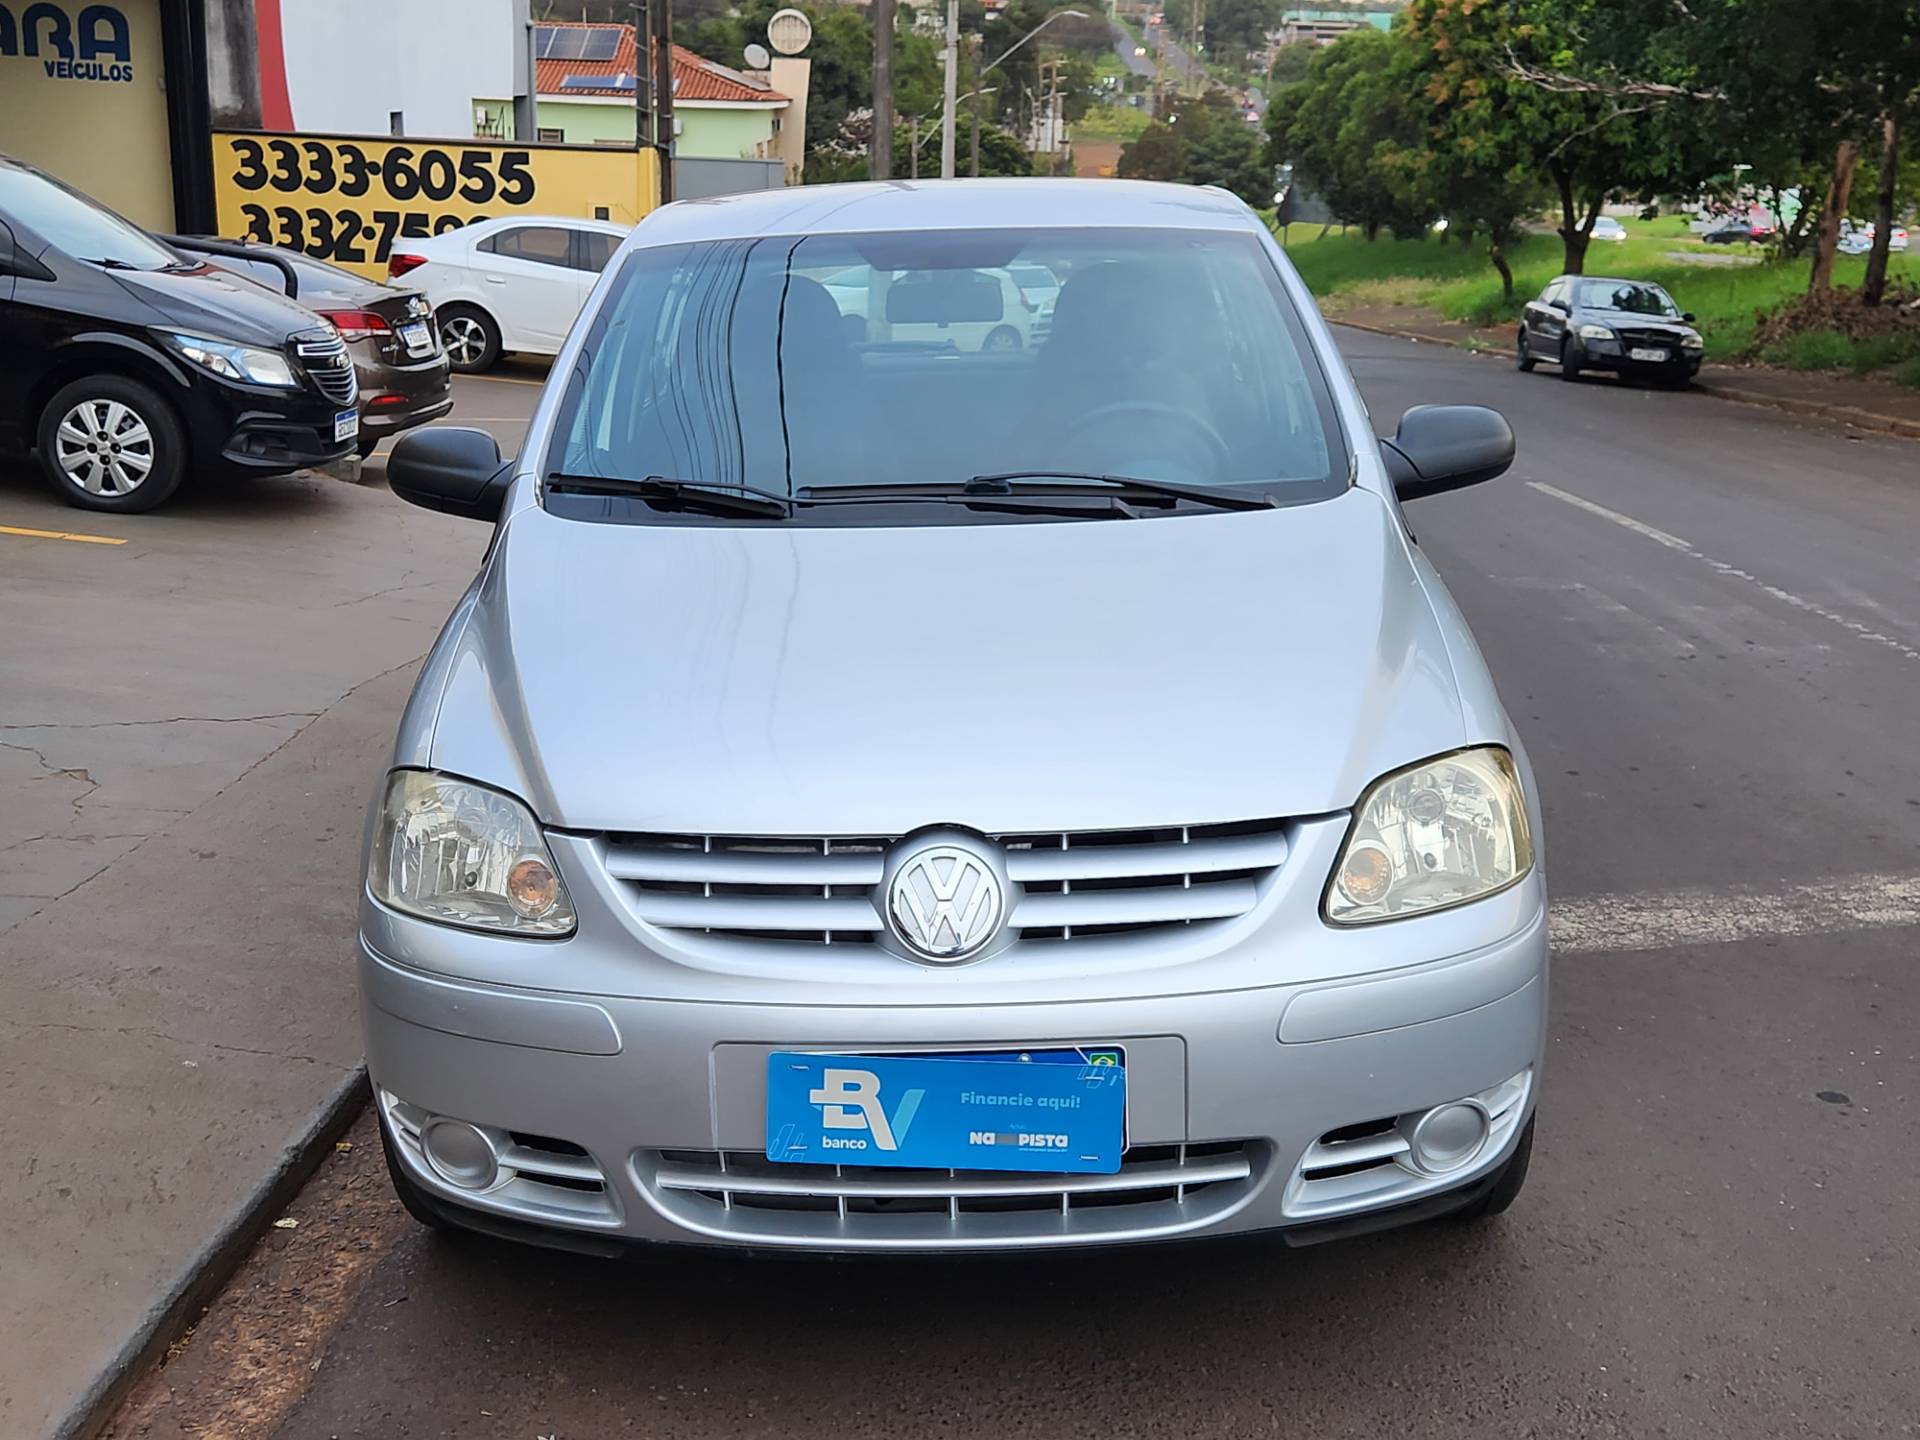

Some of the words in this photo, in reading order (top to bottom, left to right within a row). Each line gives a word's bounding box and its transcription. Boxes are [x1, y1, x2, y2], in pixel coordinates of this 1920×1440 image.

[961, 1091, 1034, 1106] Financie
[1037, 1095, 1081, 1111] aqui!
[822, 1135, 867, 1149] banco
